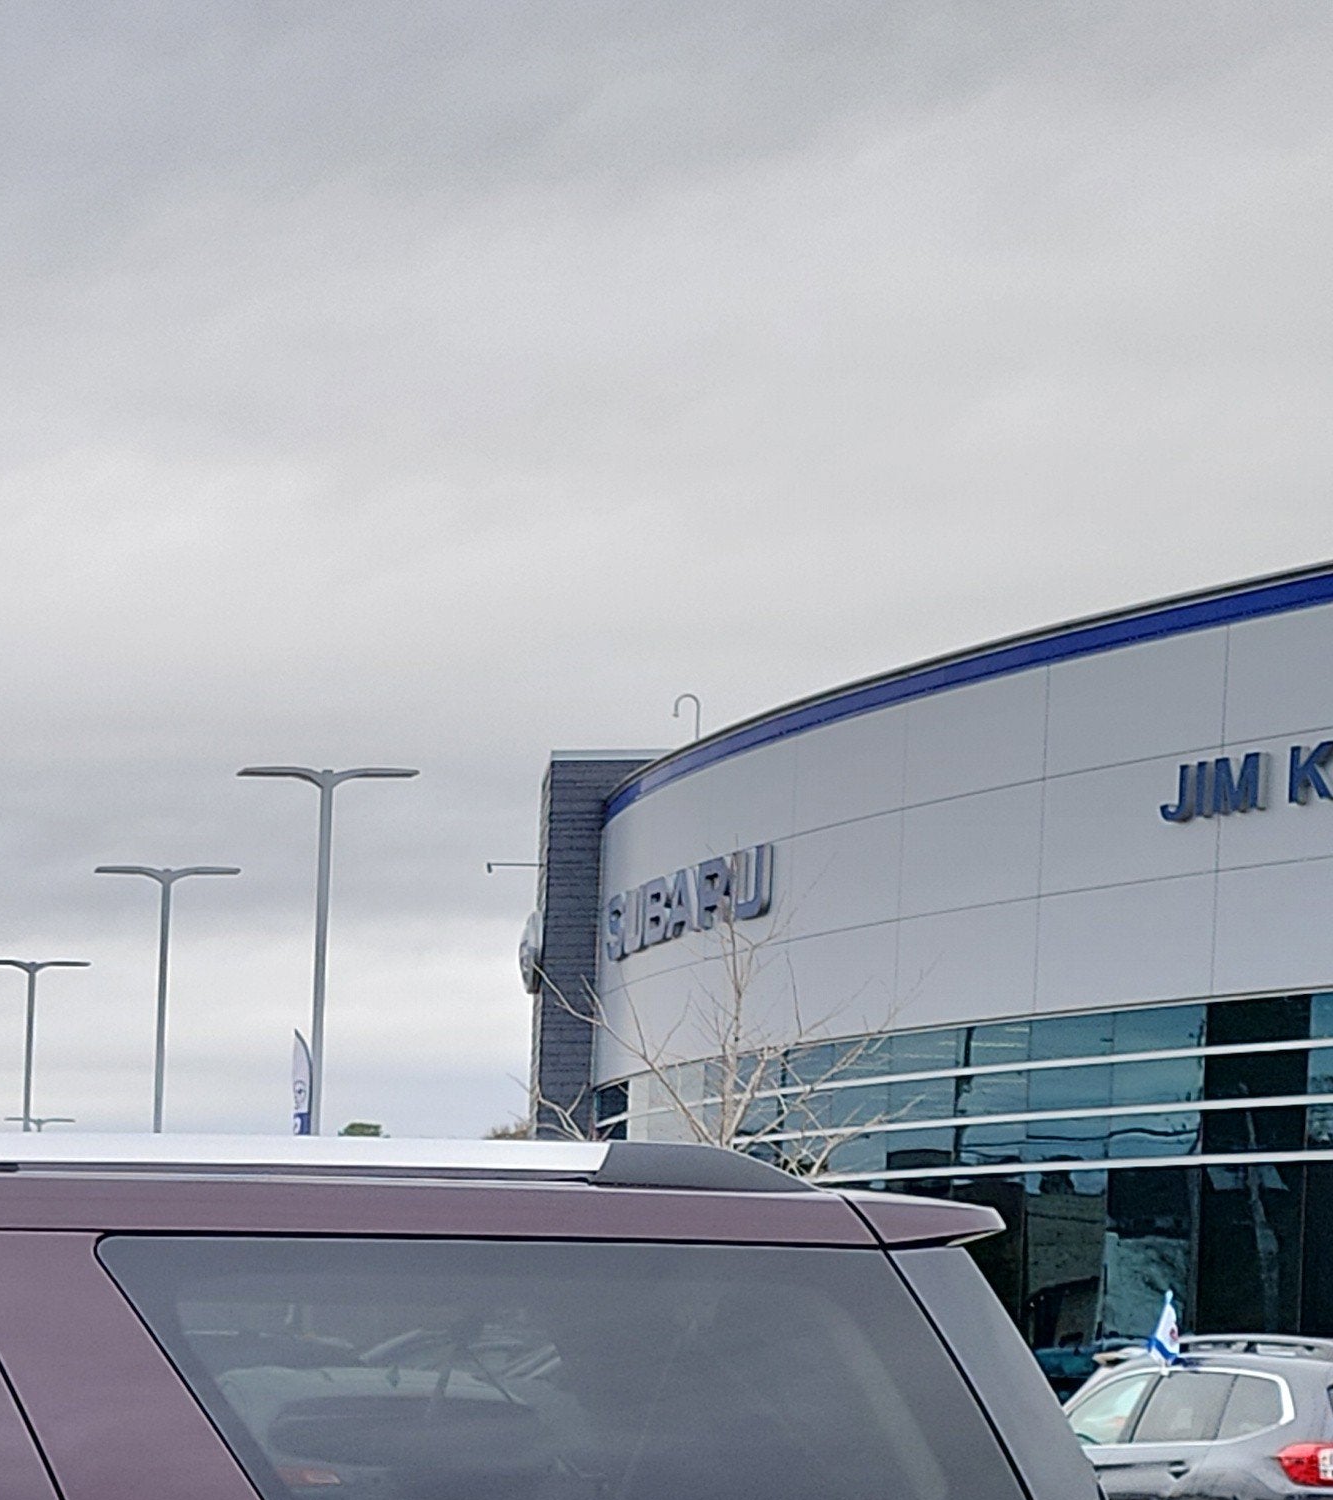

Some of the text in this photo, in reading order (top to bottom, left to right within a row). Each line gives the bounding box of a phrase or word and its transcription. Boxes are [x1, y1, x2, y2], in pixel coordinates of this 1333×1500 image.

[1160, 741, 1333, 823] JIM K
[606, 843, 773, 962] SUBARU
